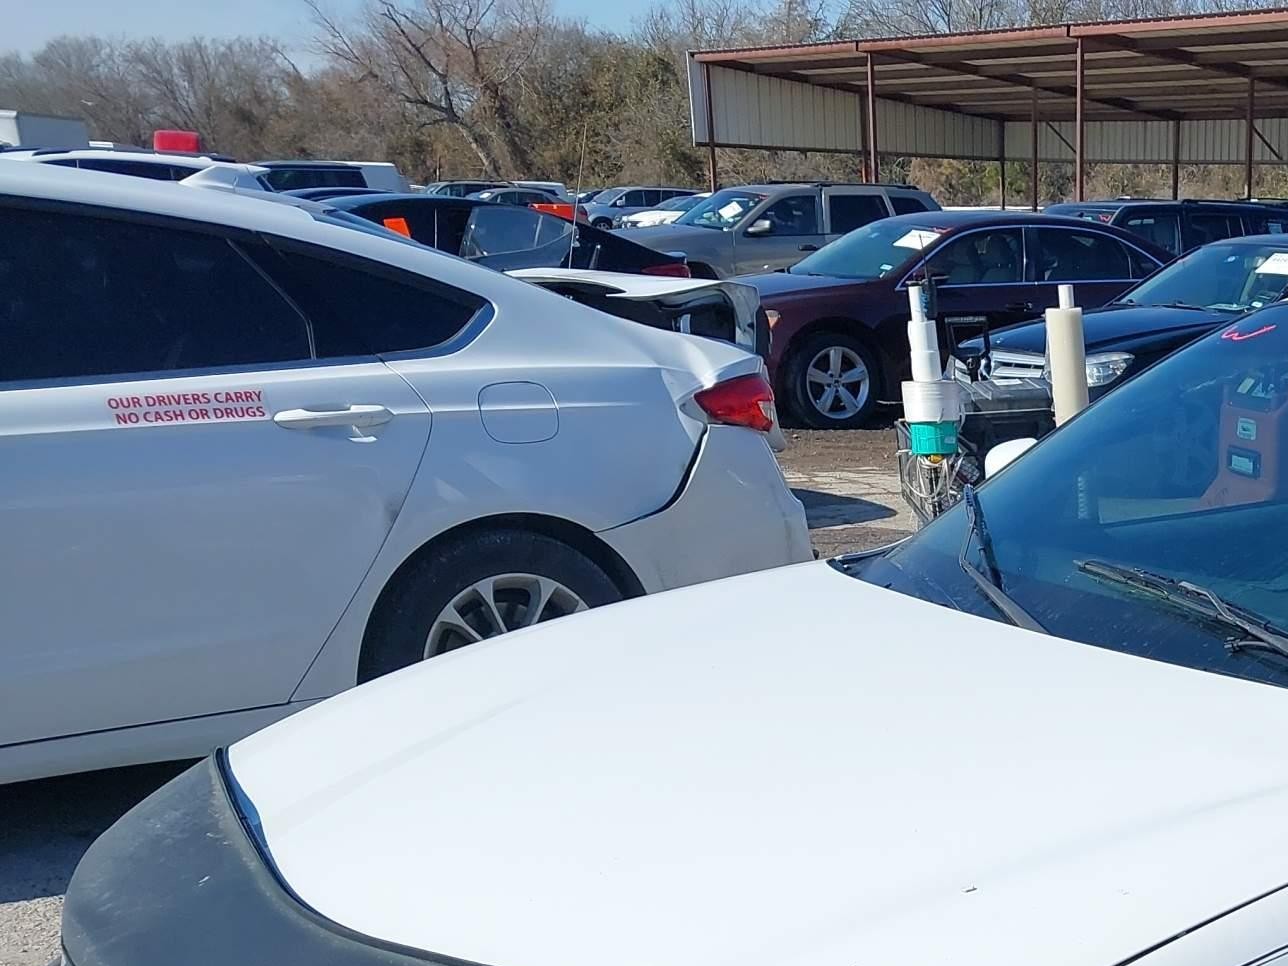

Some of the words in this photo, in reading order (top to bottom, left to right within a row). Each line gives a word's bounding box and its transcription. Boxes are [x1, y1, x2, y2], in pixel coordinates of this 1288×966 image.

[107, 396, 143, 410] OUR
[144, 392, 211, 407] DRIVERS
[213, 390, 263, 404] CARRY
[115, 412, 140, 425] NO
[143, 409, 184, 422] CASH
[188, 407, 210, 420] OR
[212, 405, 266, 419] DRUGS
